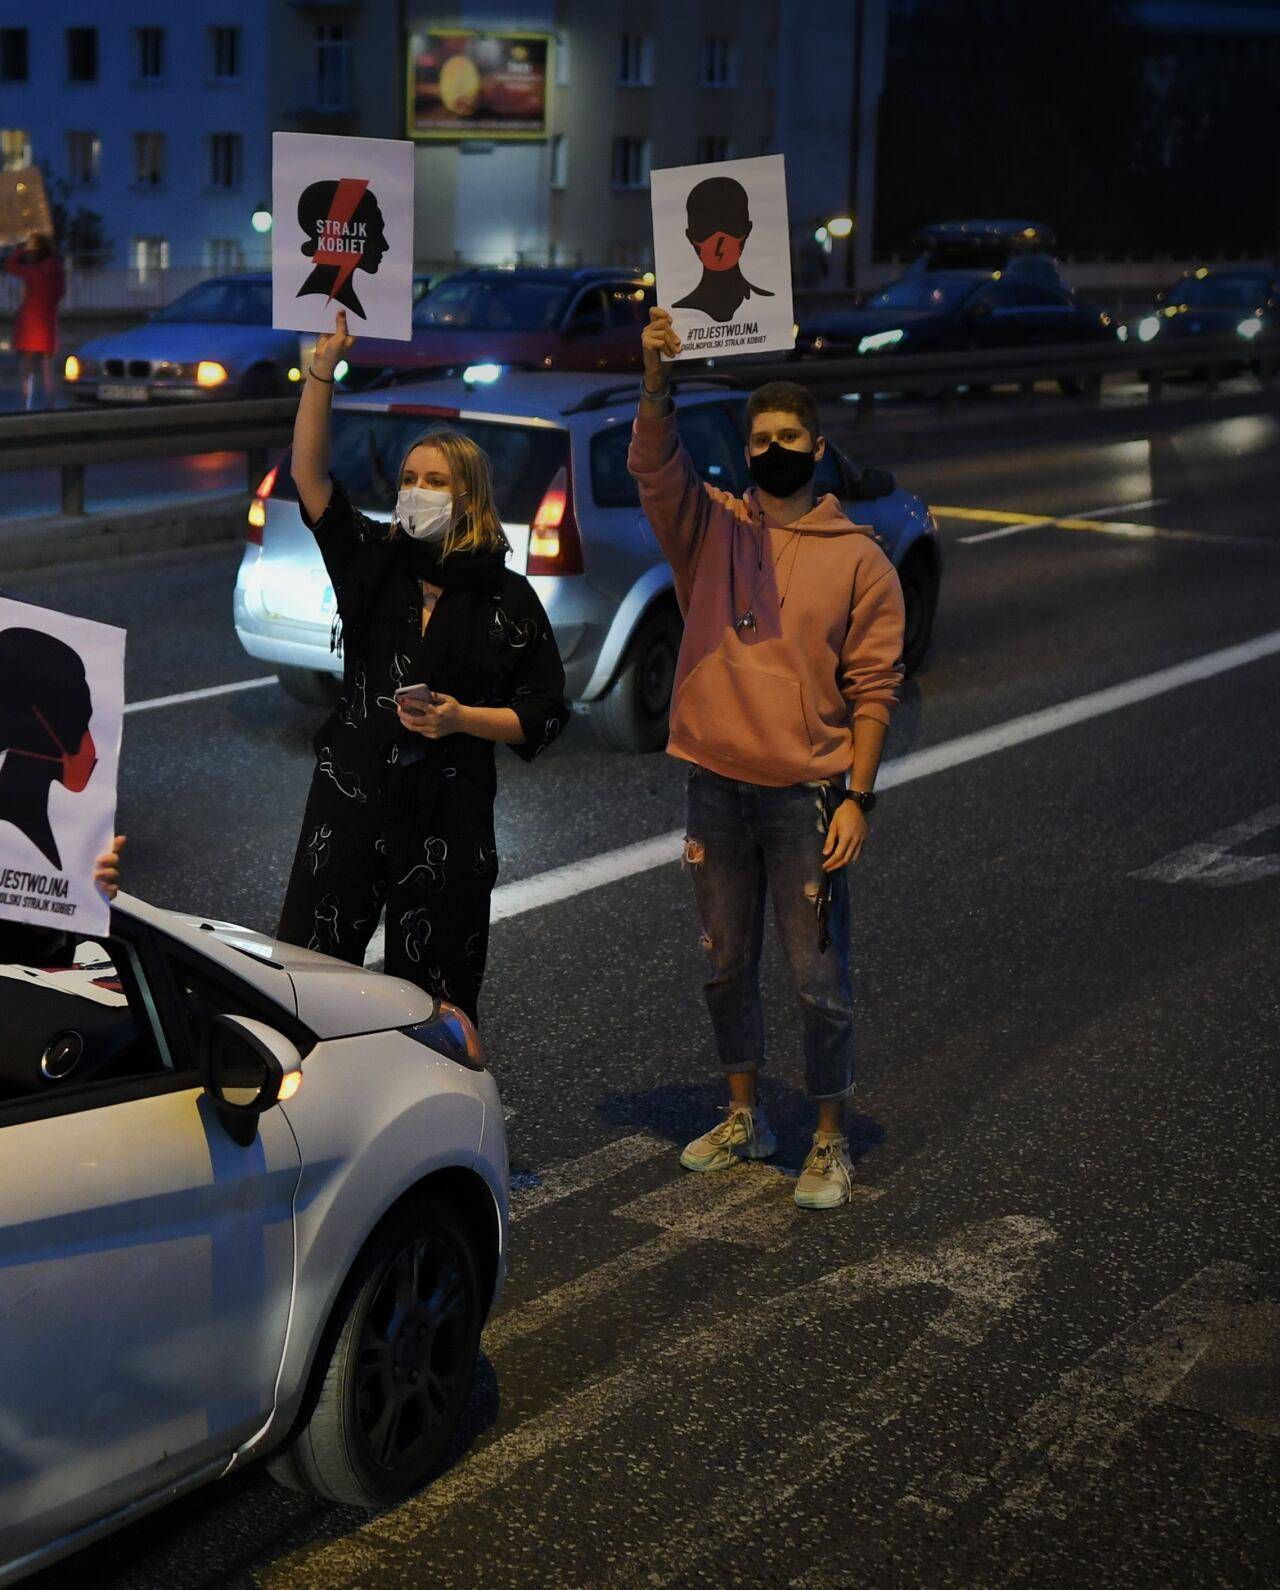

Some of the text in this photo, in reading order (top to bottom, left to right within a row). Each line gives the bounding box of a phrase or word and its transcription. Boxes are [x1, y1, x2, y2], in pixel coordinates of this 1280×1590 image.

[316, 219, 367, 236] STRAJK
[317, 236, 366, 254] KOBIET
[687, 322, 758, 341] #TOJESTWOJNA
[724, 338, 744, 347] STRAJK
[746, 336, 766, 344] KOBIET
[23, 896, 50, 911] STRAJK
[50, 902, 77, 916] KOBIET
